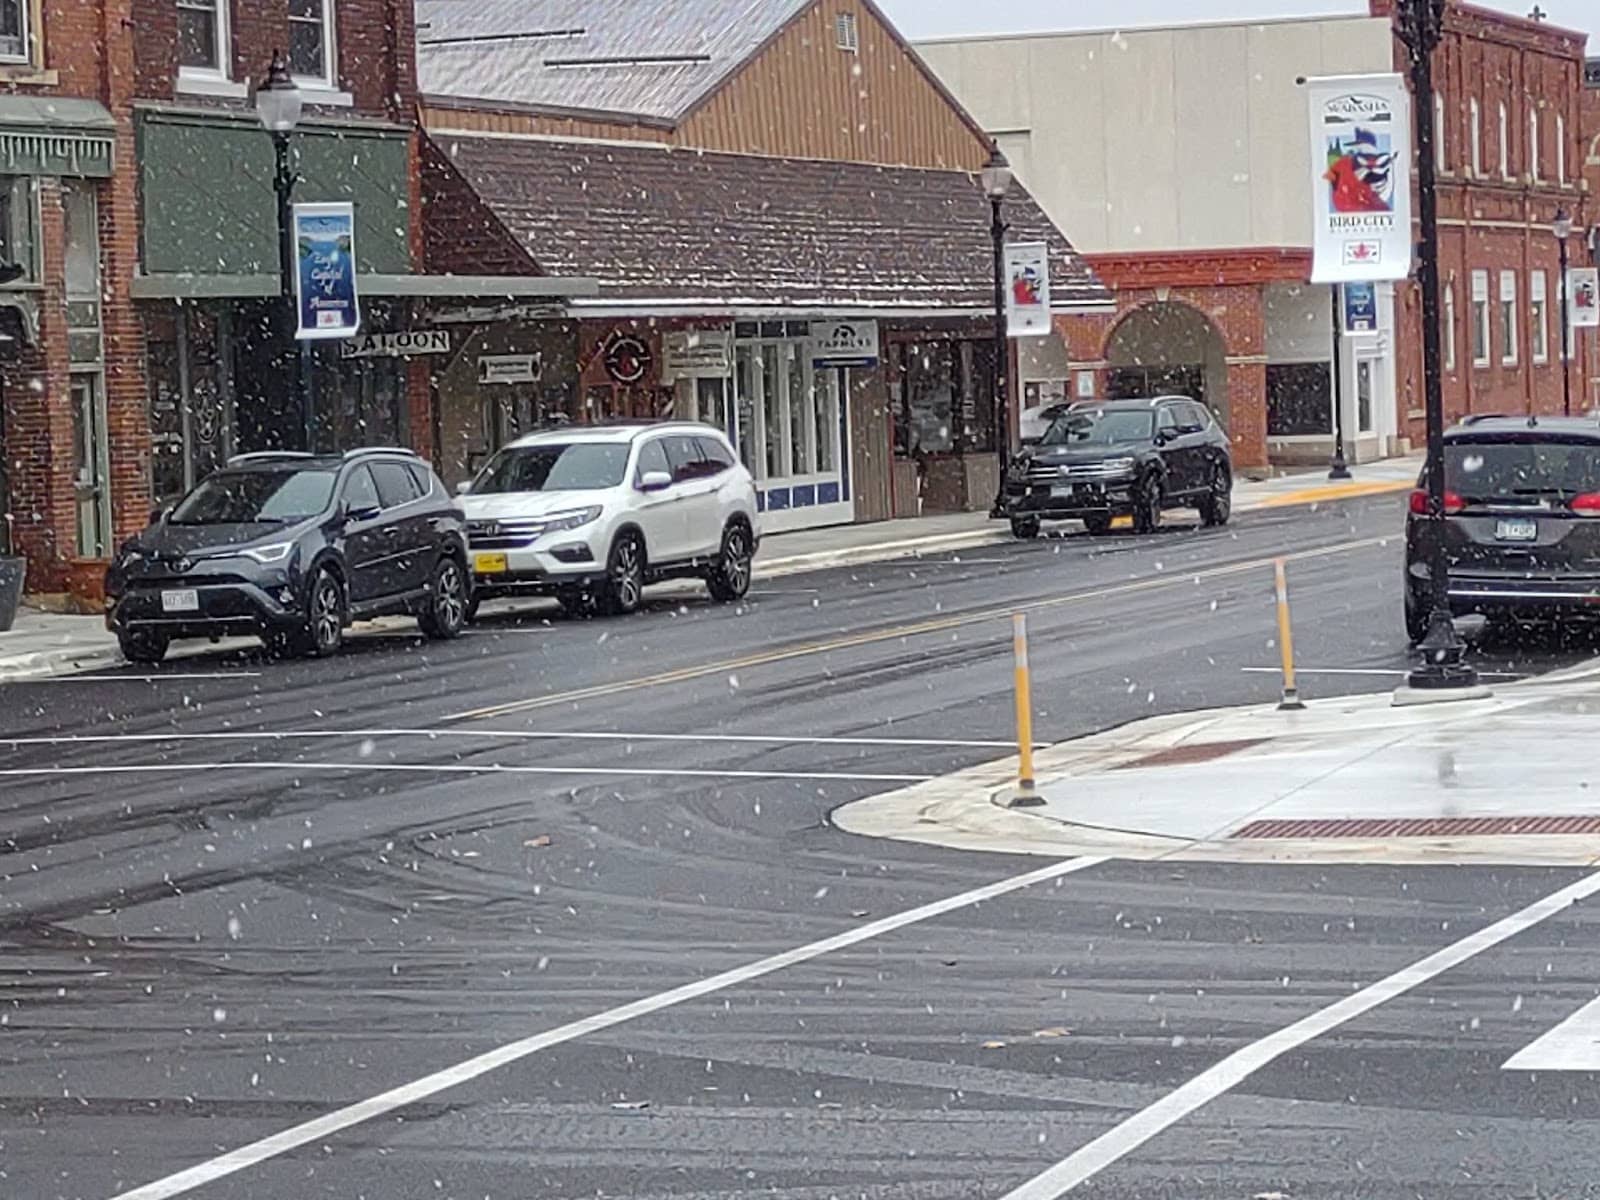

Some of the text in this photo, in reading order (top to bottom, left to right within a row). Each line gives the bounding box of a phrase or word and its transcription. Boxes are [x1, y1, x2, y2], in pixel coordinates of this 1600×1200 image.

[1329, 214, 1394, 229] BIRD CITY
[343, 333, 447, 354] SALOON
